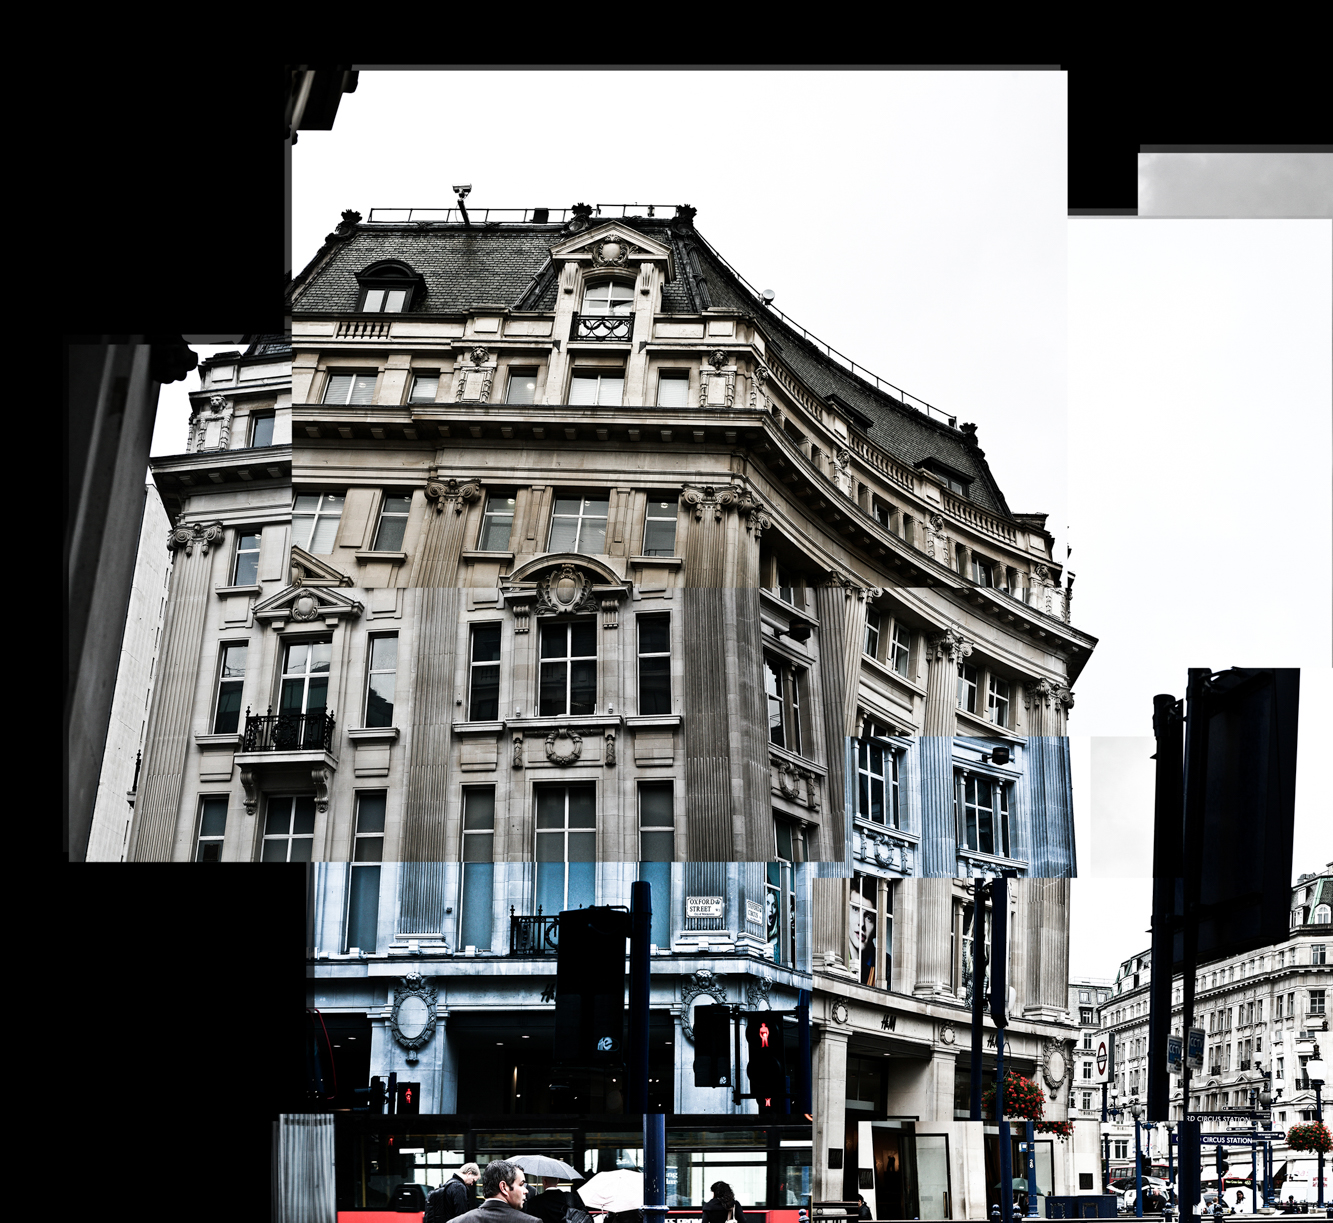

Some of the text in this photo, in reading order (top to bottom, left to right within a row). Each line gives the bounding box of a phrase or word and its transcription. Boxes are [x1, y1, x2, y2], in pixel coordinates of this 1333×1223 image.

[881, 1014, 897, 1032] H&M
[1202, 1136, 1253, 1145] CIRCUS STATION
